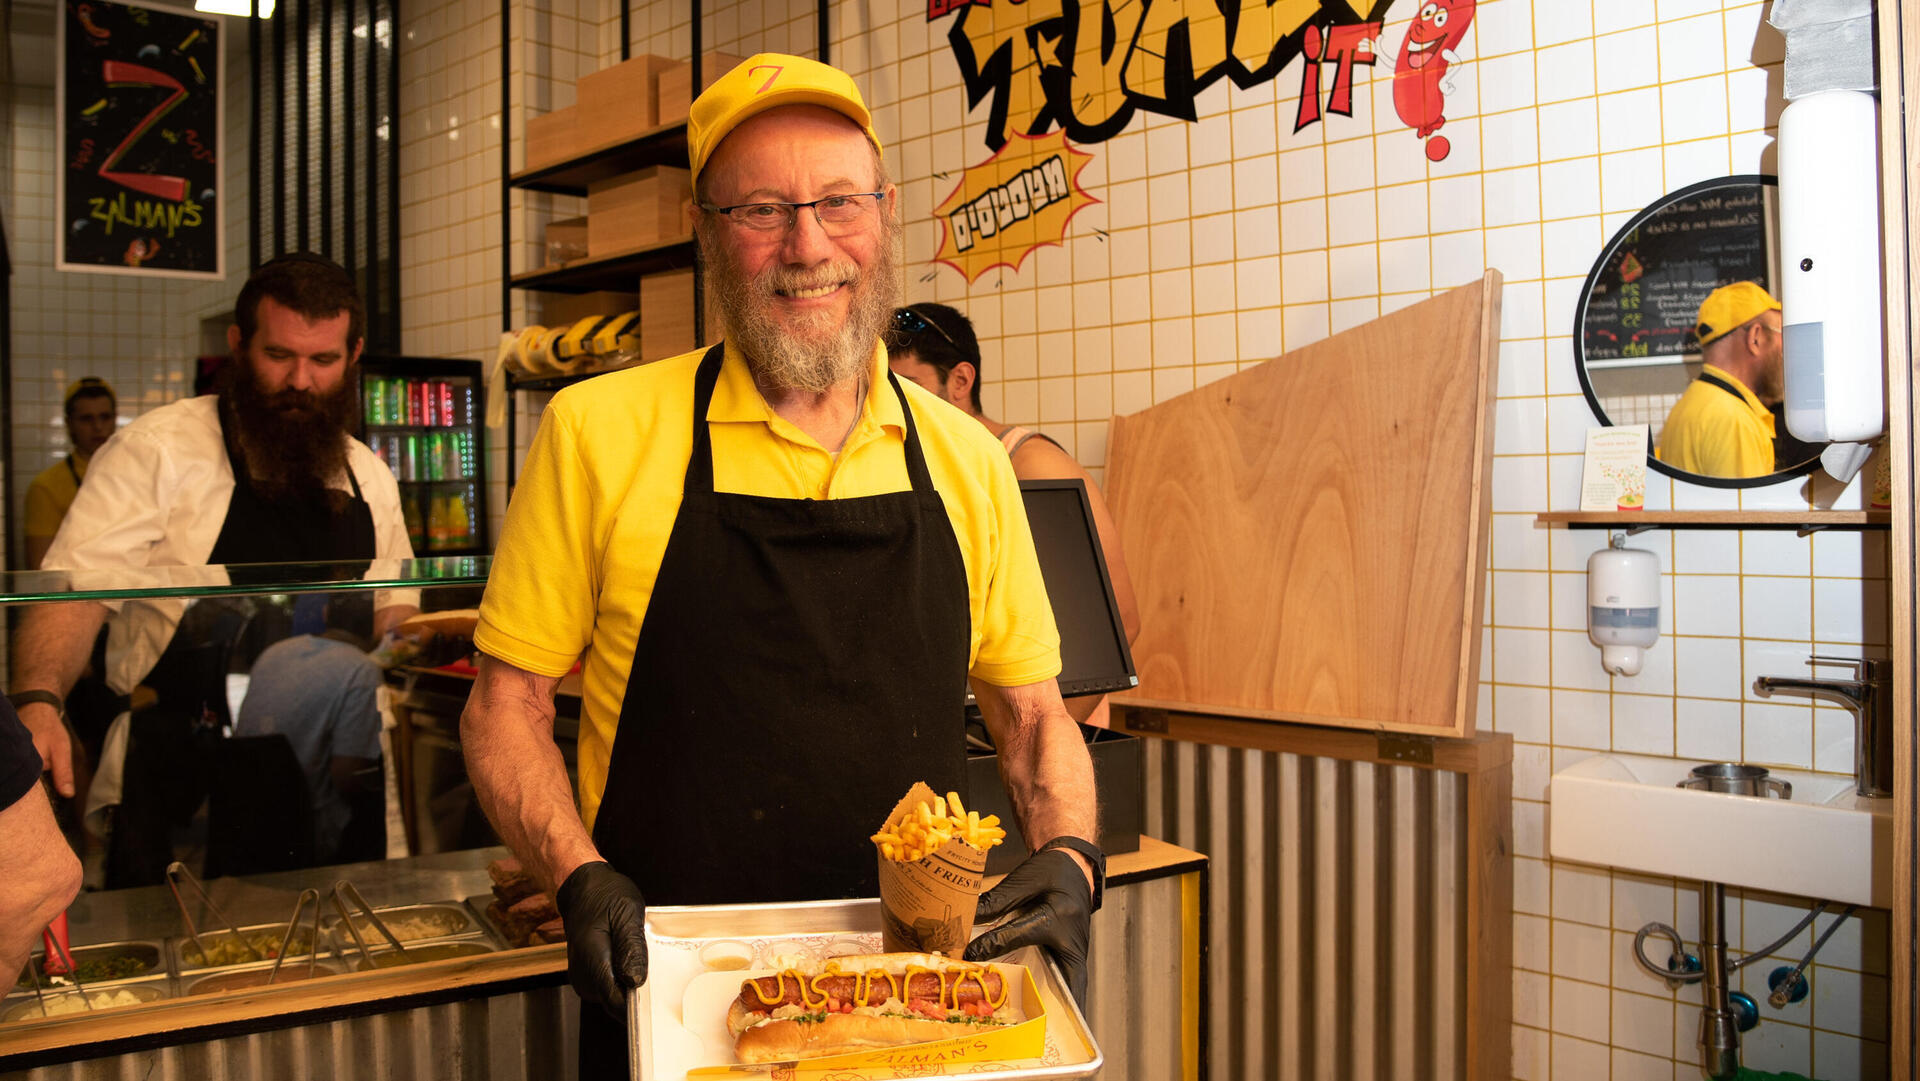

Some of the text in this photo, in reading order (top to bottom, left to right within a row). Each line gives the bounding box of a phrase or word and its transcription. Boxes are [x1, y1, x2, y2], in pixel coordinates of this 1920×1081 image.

[99, 60, 190, 201] Z
[88, 192, 203, 238] ZALMAN'S
[933, 866, 974, 889] FRIES
